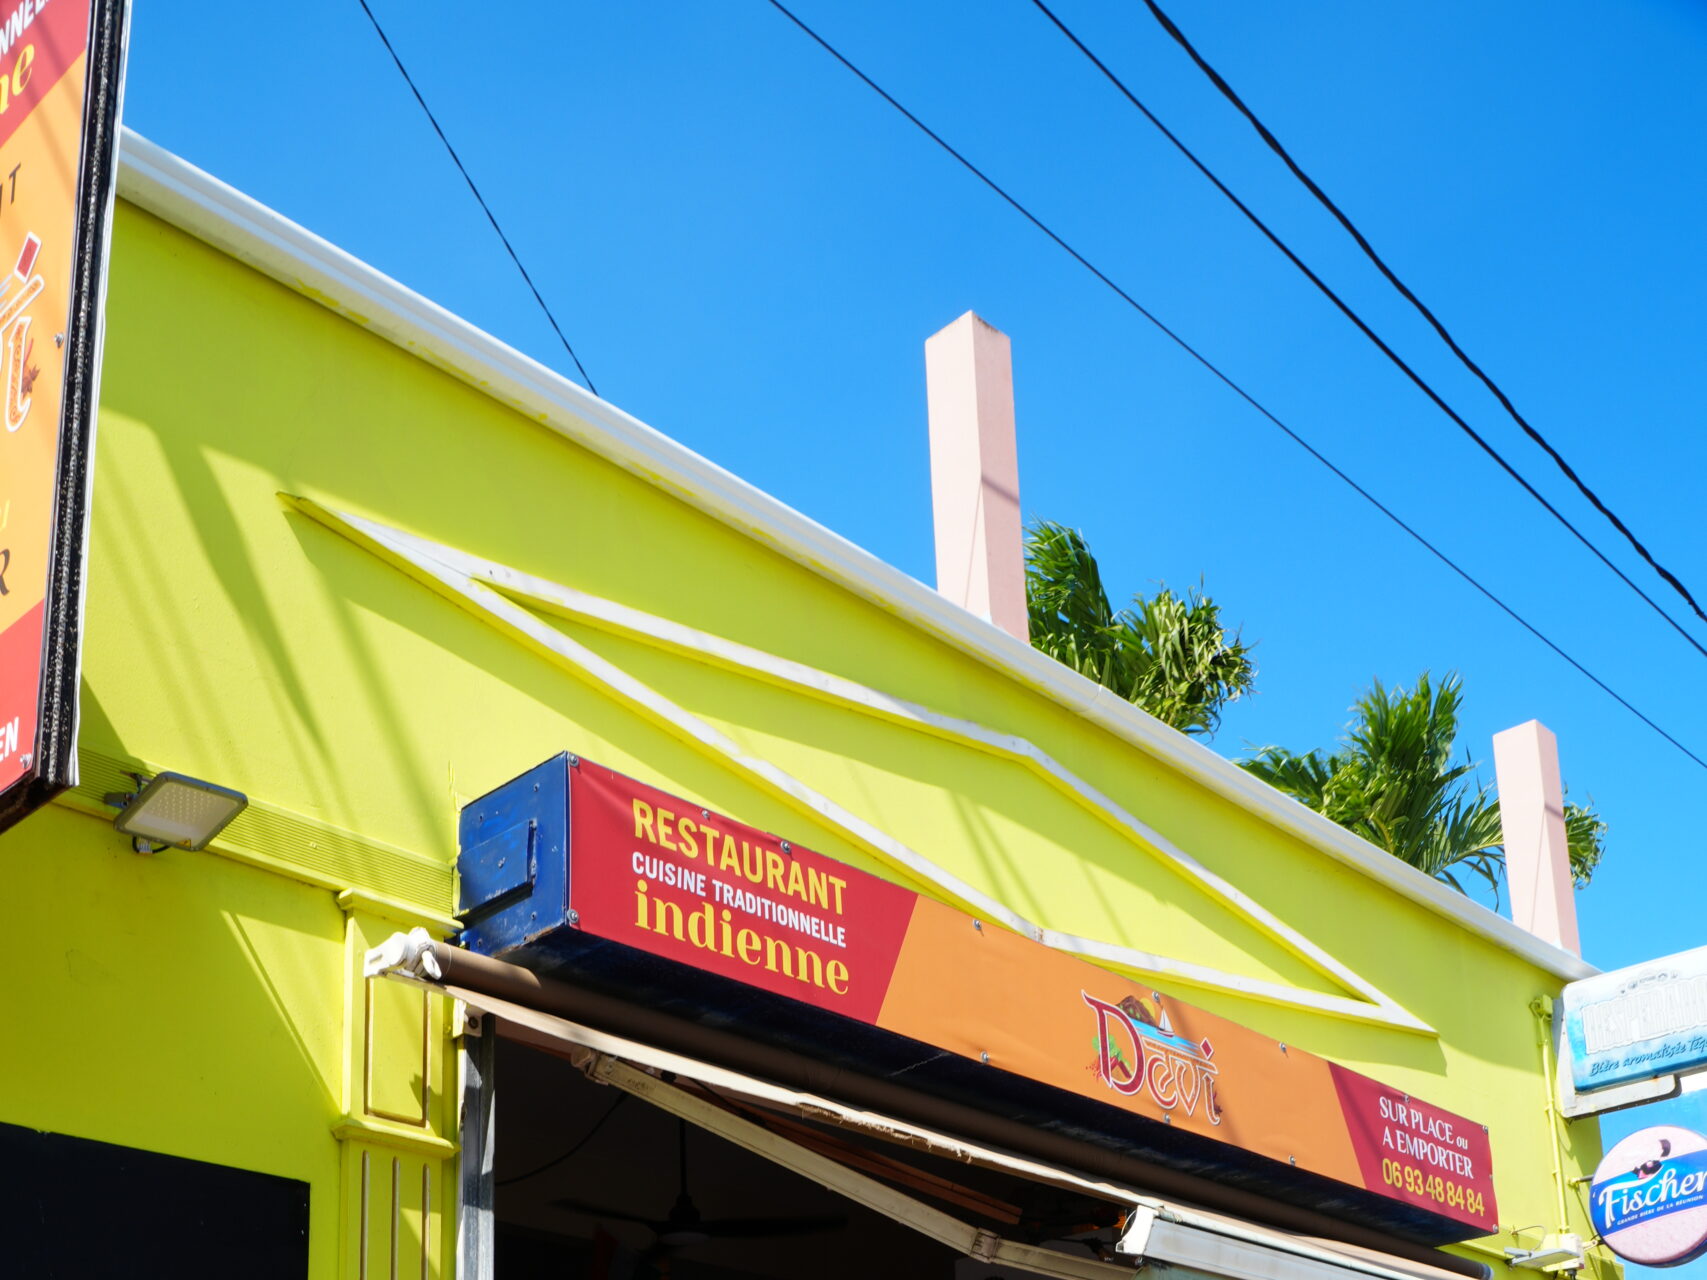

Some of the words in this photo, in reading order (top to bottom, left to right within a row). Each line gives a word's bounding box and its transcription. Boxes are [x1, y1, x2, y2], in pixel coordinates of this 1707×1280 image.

[632, 798, 847, 916] RESTAURANT
[632, 852, 707, 897] CUISINE
[712, 879, 846, 949] TRADITIONNELLE
[634, 879, 849, 995] indienne
[1081, 989, 1221, 1126] Devi
[1379, 1096, 1408, 1127] SUR
[1410, 1108, 1454, 1144] PLACE
[1456, 1136, 1469, 1150] ou
[1382, 1126, 1394, 1150] A
[1396, 1130, 1474, 1179] EMPORTER
[1382, 1158, 1402, 1188] 06
[1404, 1166, 1424, 1196] 93
[1426, 1175, 1445, 1203] 48
[1447, 1181, 1465, 1210] 84
[1466, 1188, 1485, 1217] 84
[1598, 1165, 1707, 1230] Fischer
